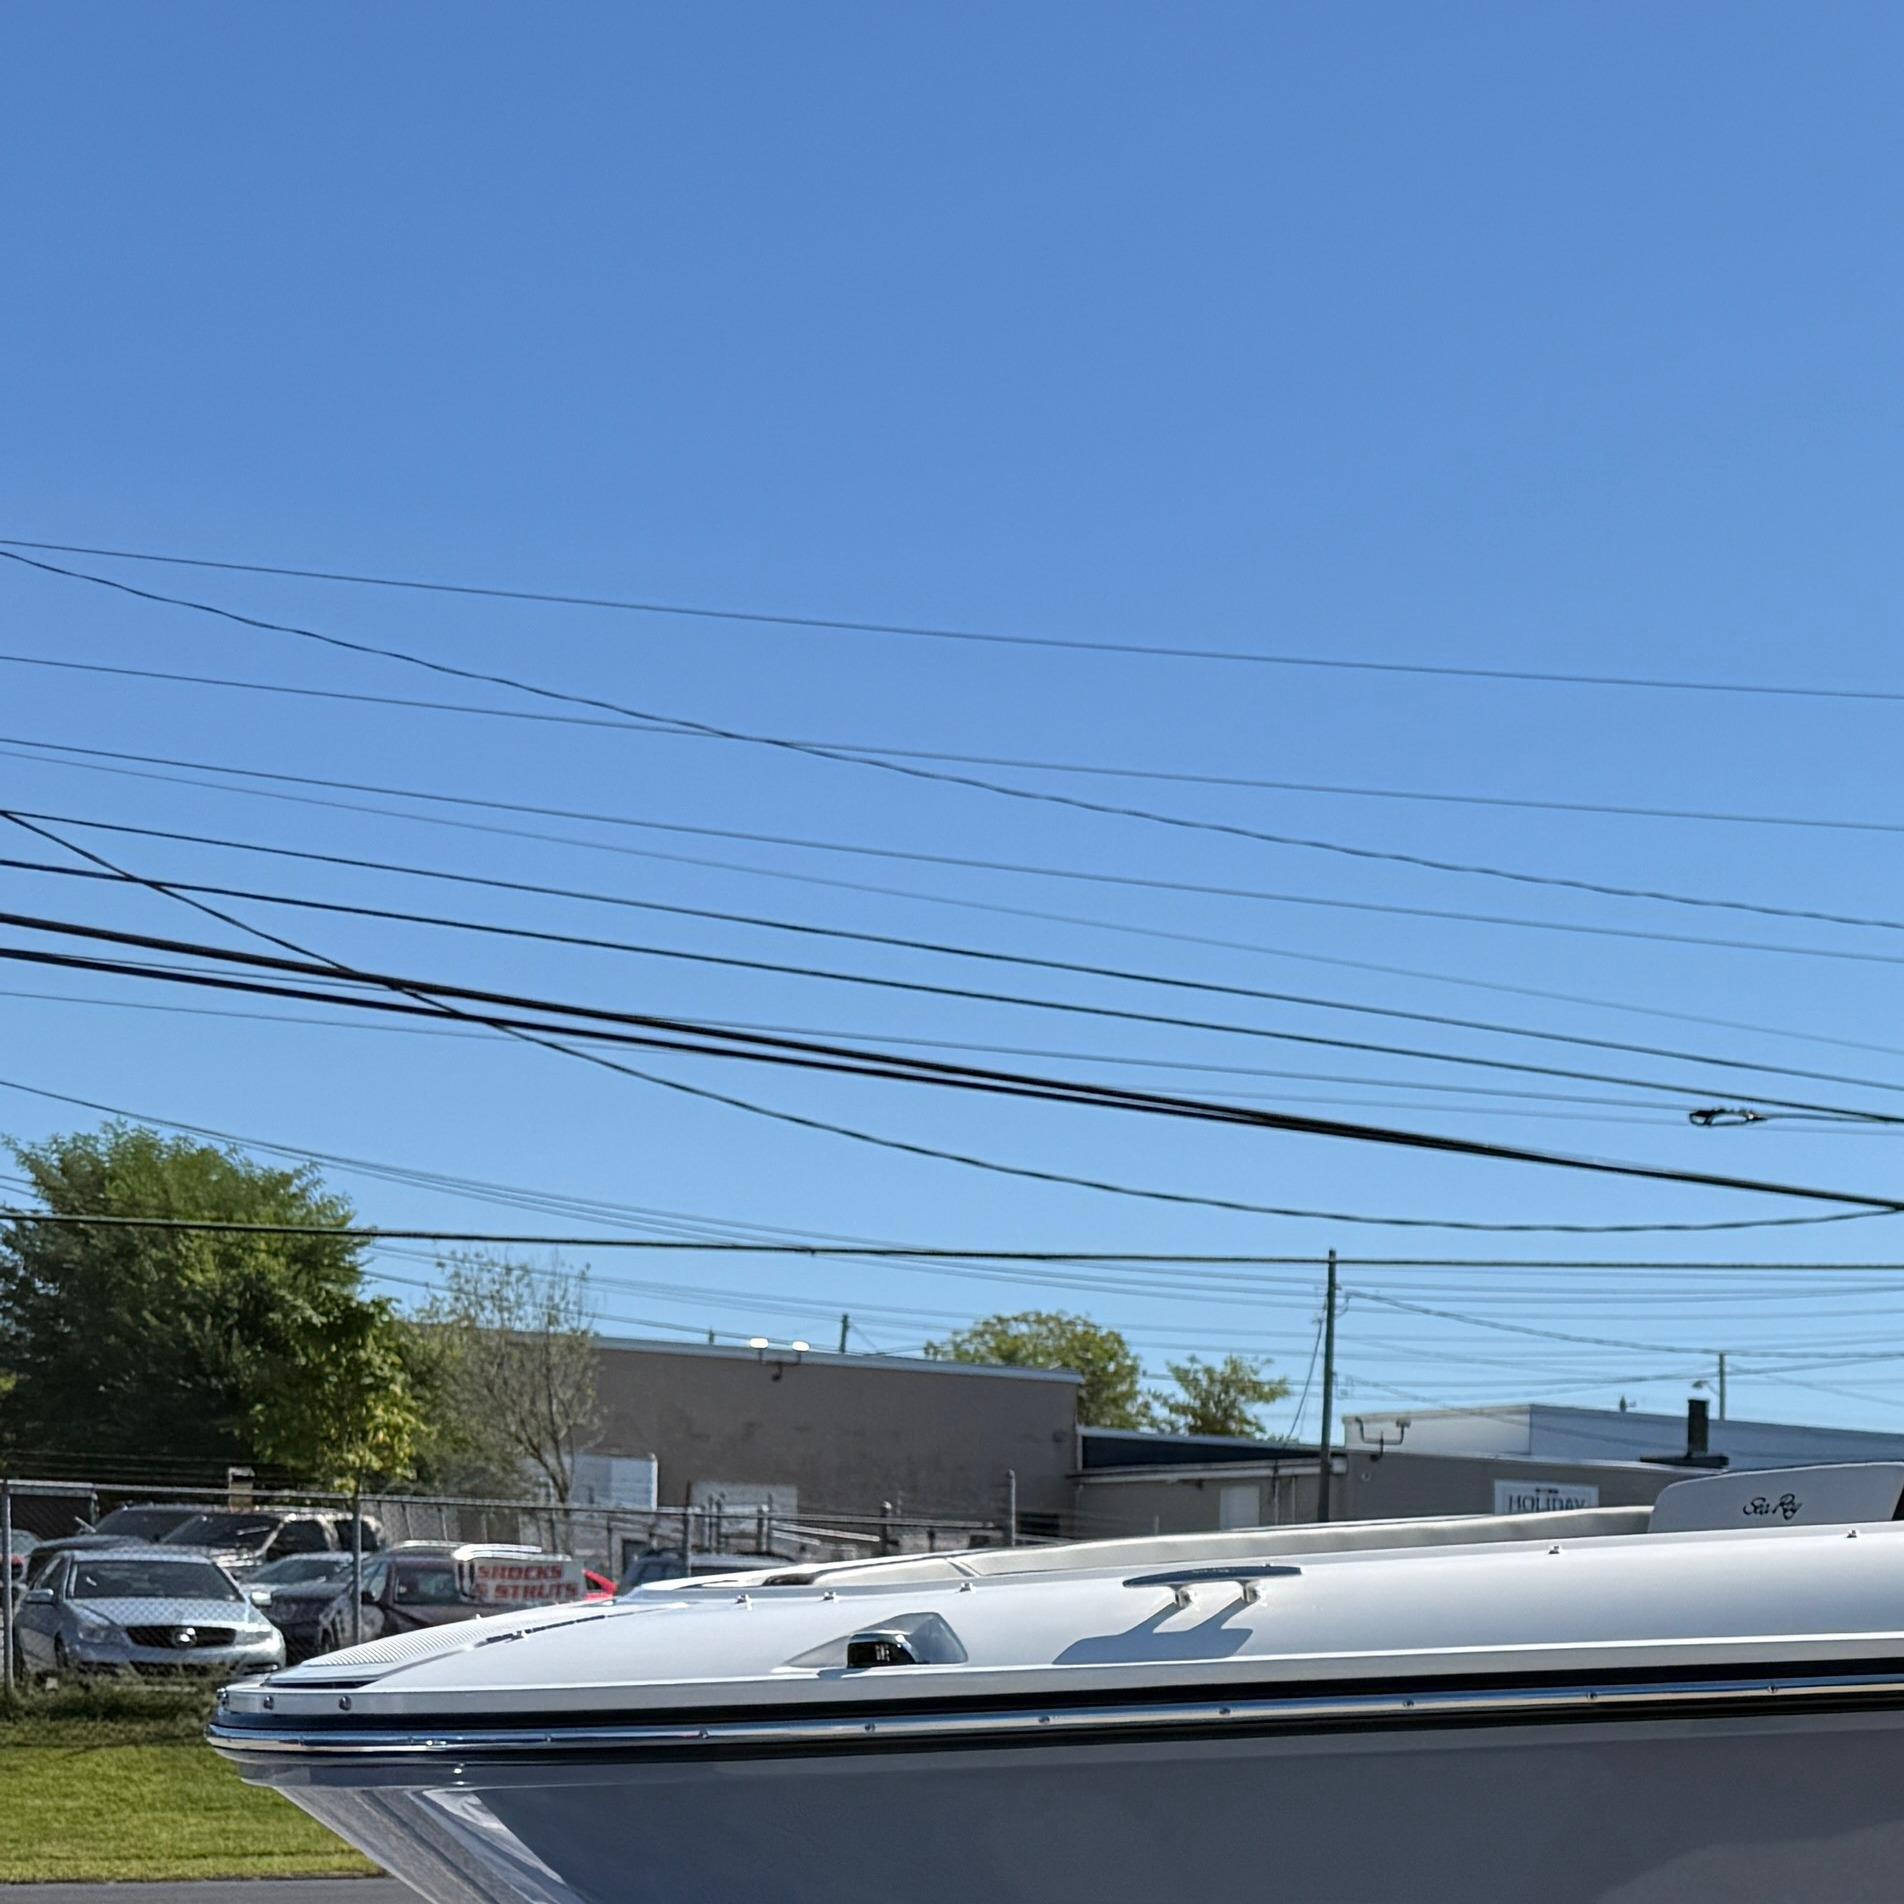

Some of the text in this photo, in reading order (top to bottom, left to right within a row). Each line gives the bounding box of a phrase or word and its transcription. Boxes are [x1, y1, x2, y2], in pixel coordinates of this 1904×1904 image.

[1508, 1495, 1586, 1513] HOLIDAY
[478, 1565, 562, 1581] SHOCKS
[494, 1582, 578, 1599] STRUTS
